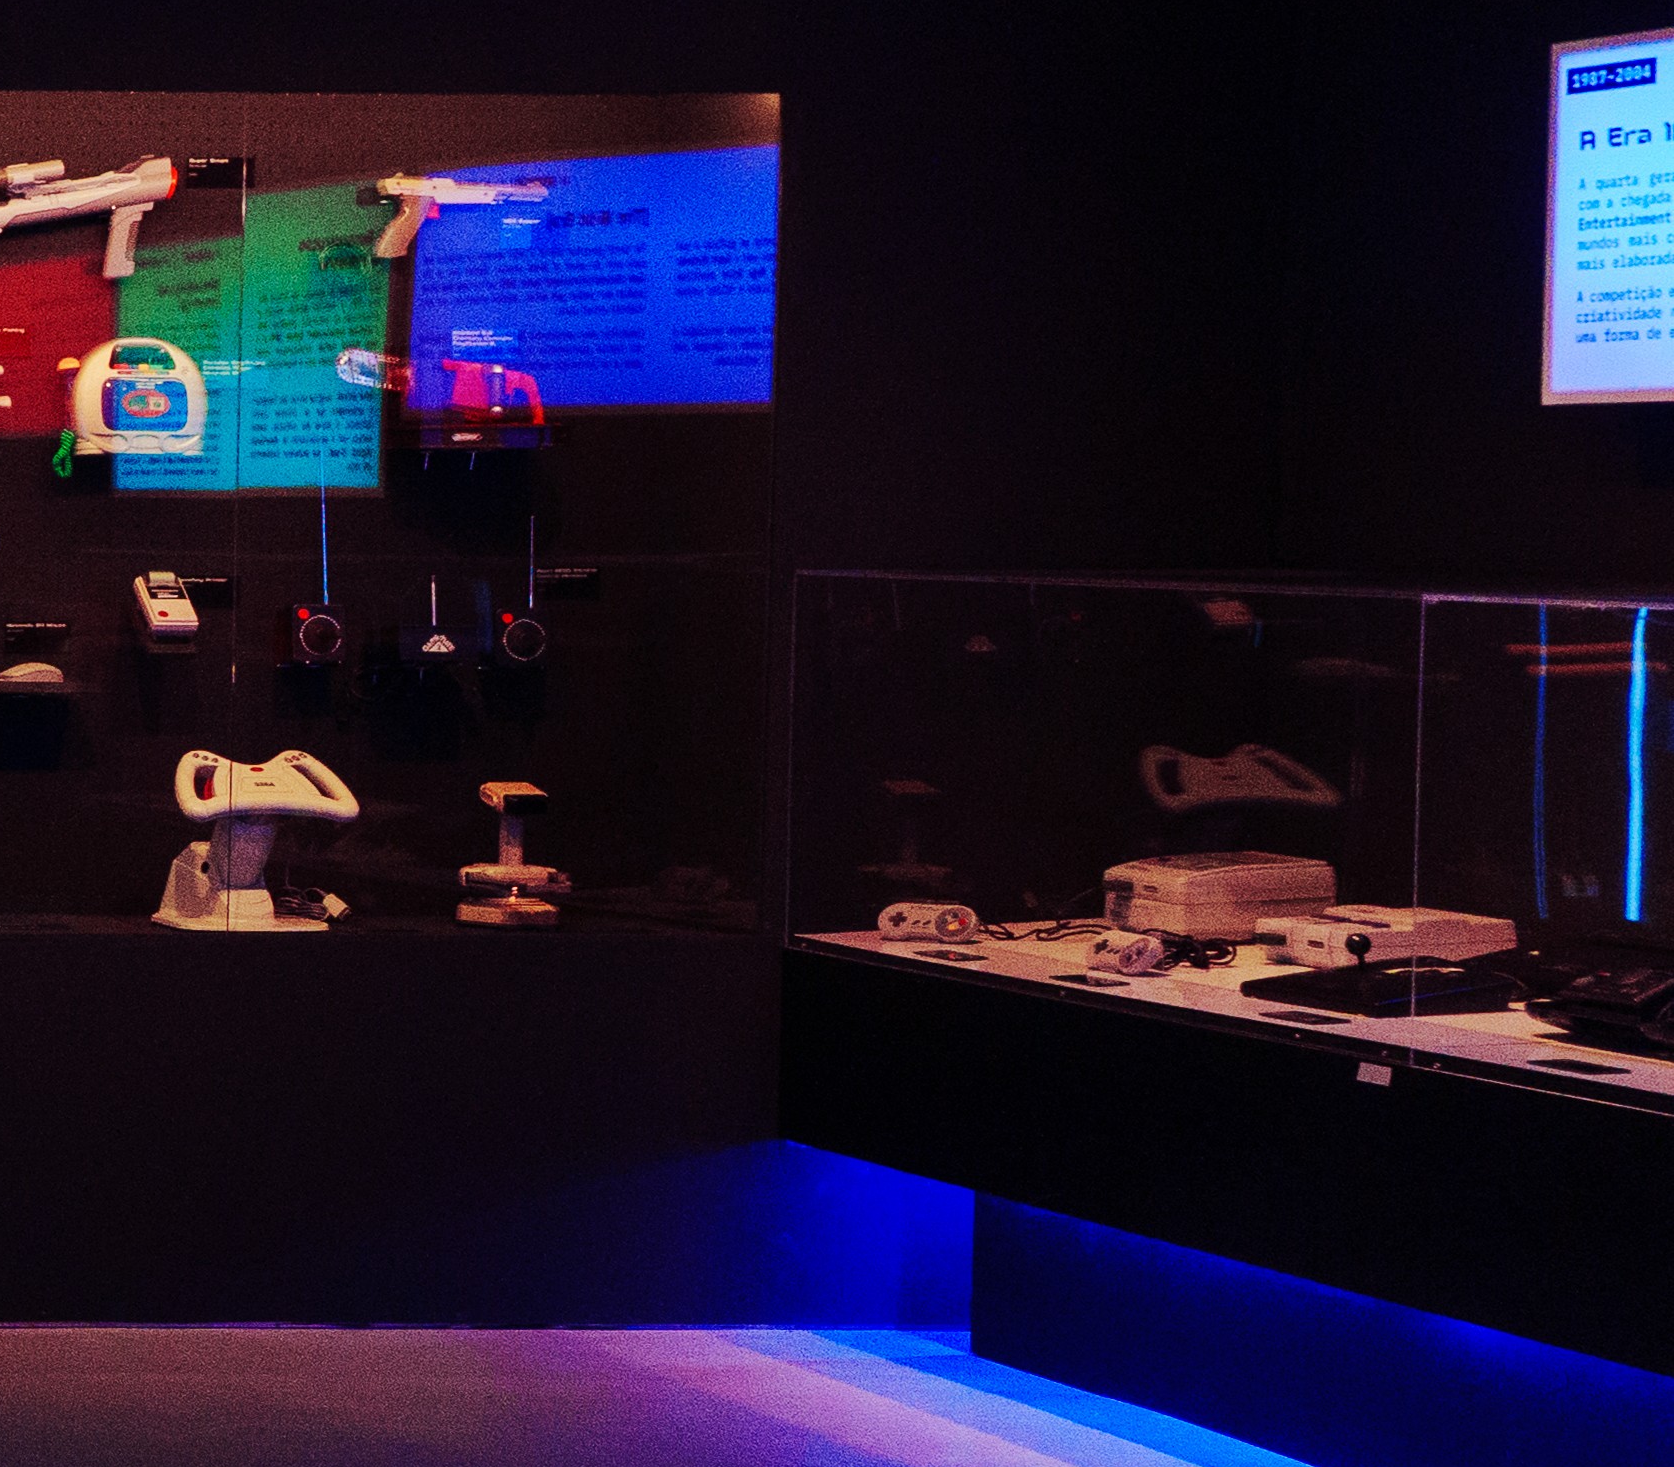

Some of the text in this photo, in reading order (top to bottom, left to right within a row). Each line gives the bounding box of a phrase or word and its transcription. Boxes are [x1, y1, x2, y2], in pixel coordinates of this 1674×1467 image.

[1579, 130, 1596, 151] A
[1608, 127, 1652, 147] Era
[1579, 178, 1586, 190] A
[1596, 176, 1639, 190] quarta
[1578, 192, 1671, 211] com a chegada
[1578, 213, 1671, 231] Entertainment
[1577, 233, 1658, 250] mundos mais
[1577, 258, 1605, 270] mais
[1577, 286, 1662, 303] A competição
[1576, 307, 1662, 323] criatividade
[1576, 326, 1662, 342] uma forma de
